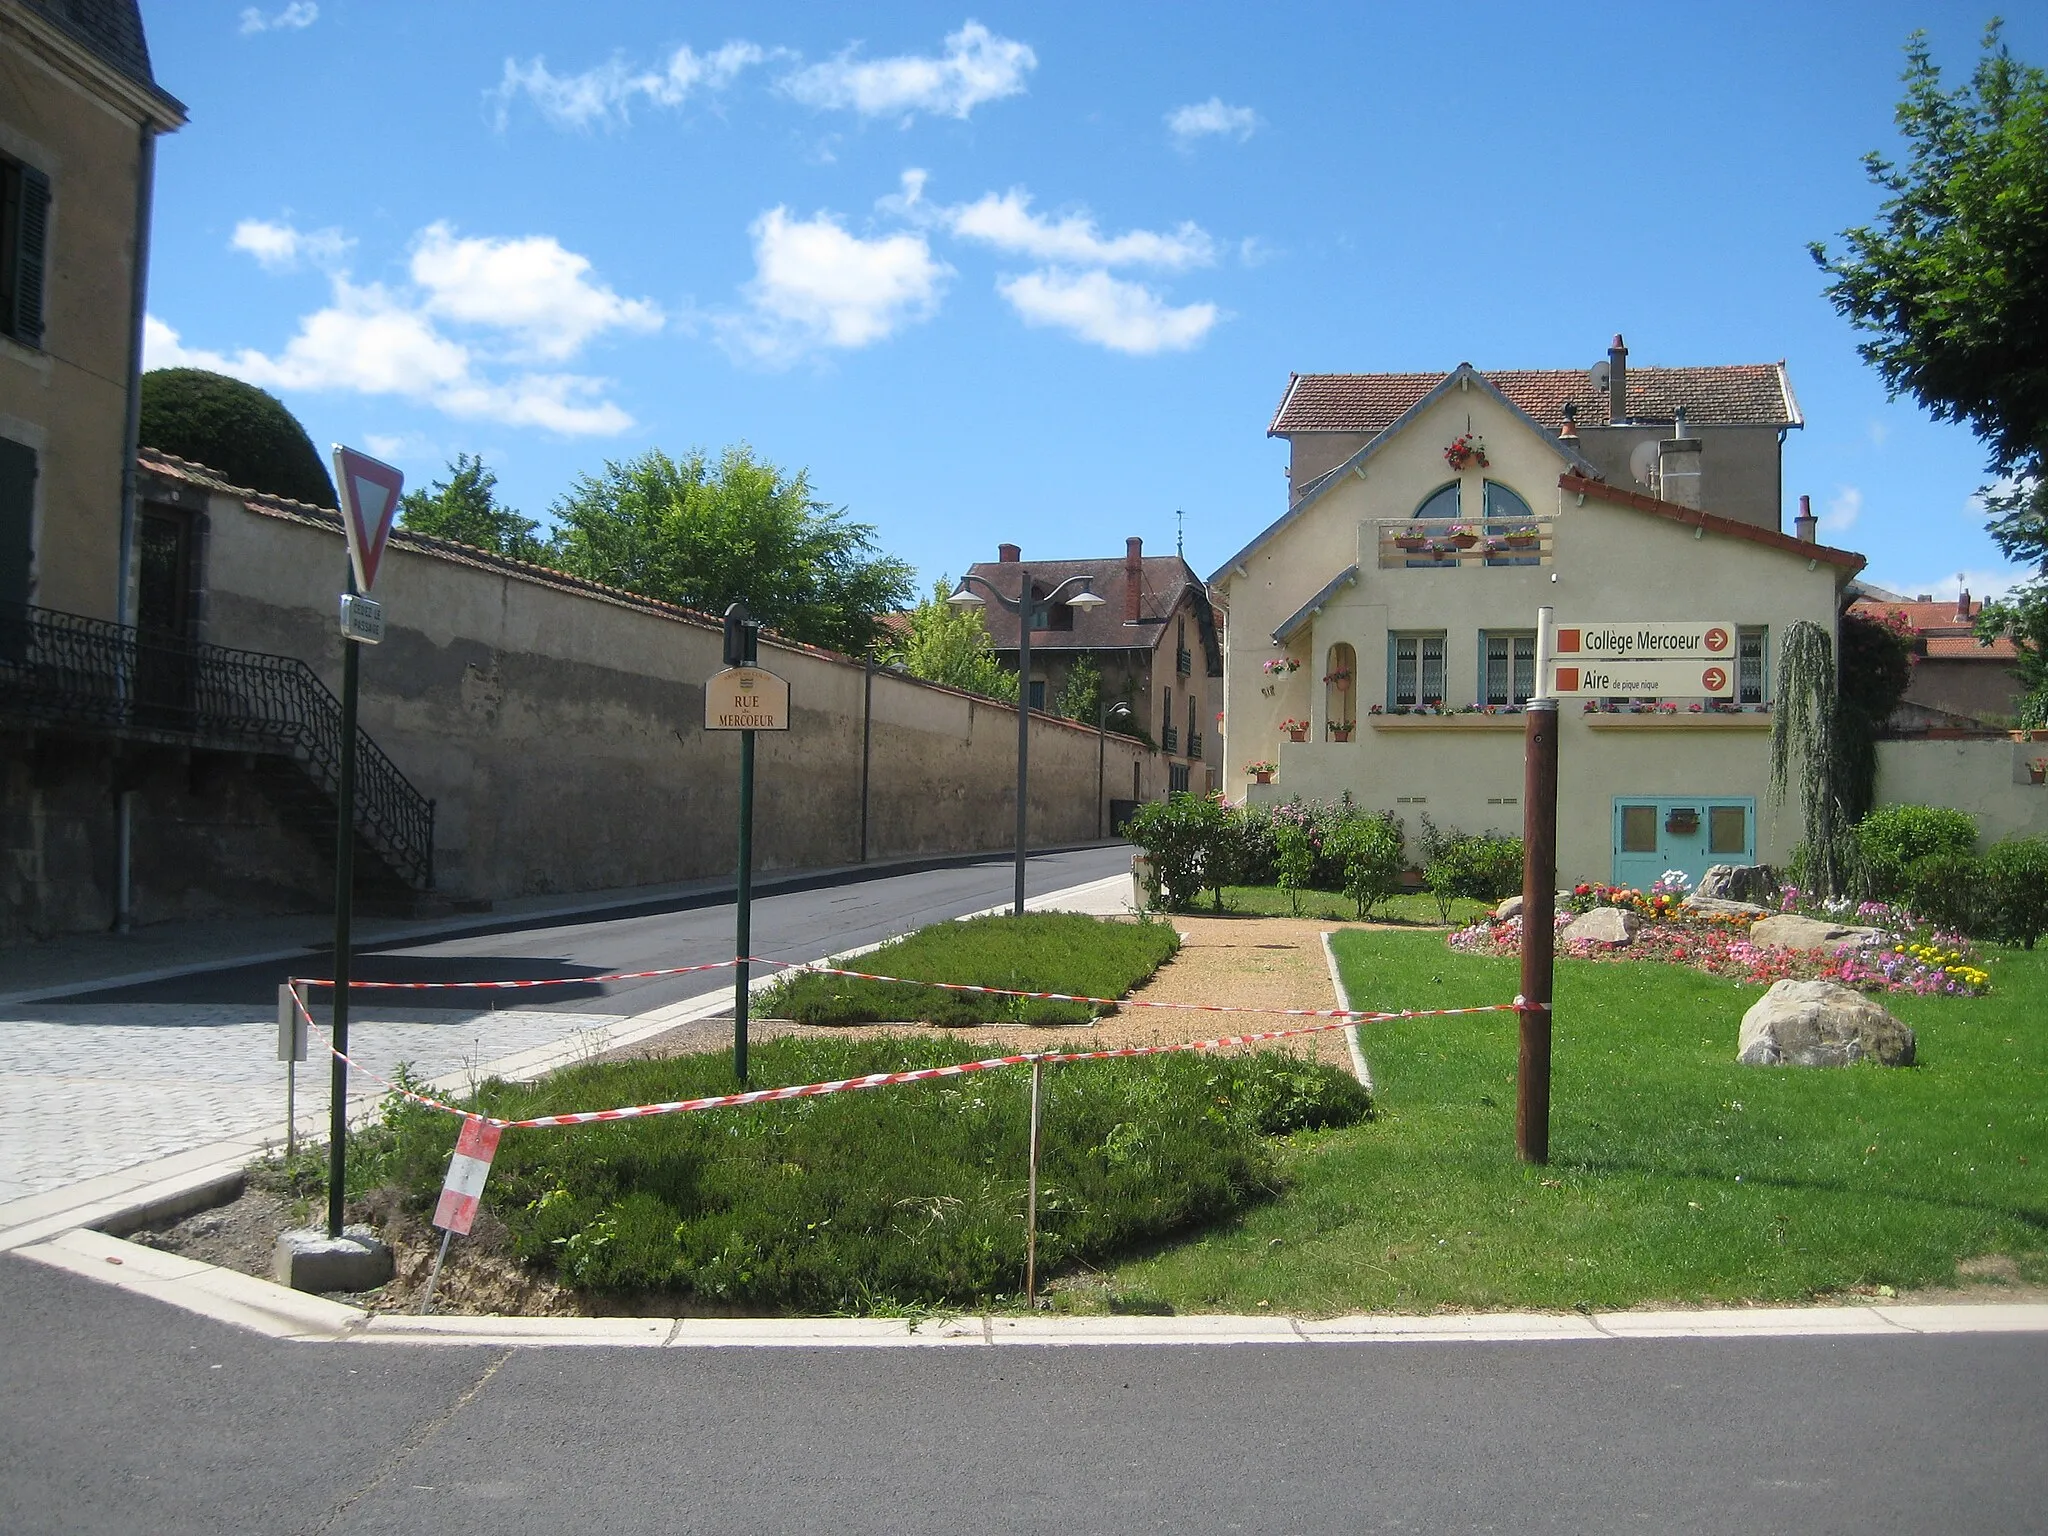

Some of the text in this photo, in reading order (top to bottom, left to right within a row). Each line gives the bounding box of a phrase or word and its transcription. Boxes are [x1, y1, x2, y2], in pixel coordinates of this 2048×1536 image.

[1585, 630, 1700, 655] Collège Mercoeur
[1583, 669, 1659, 691] Aire de pique nique
[735, 695, 759, 708] RUE
[719, 714, 774, 727] MERCOEUR
